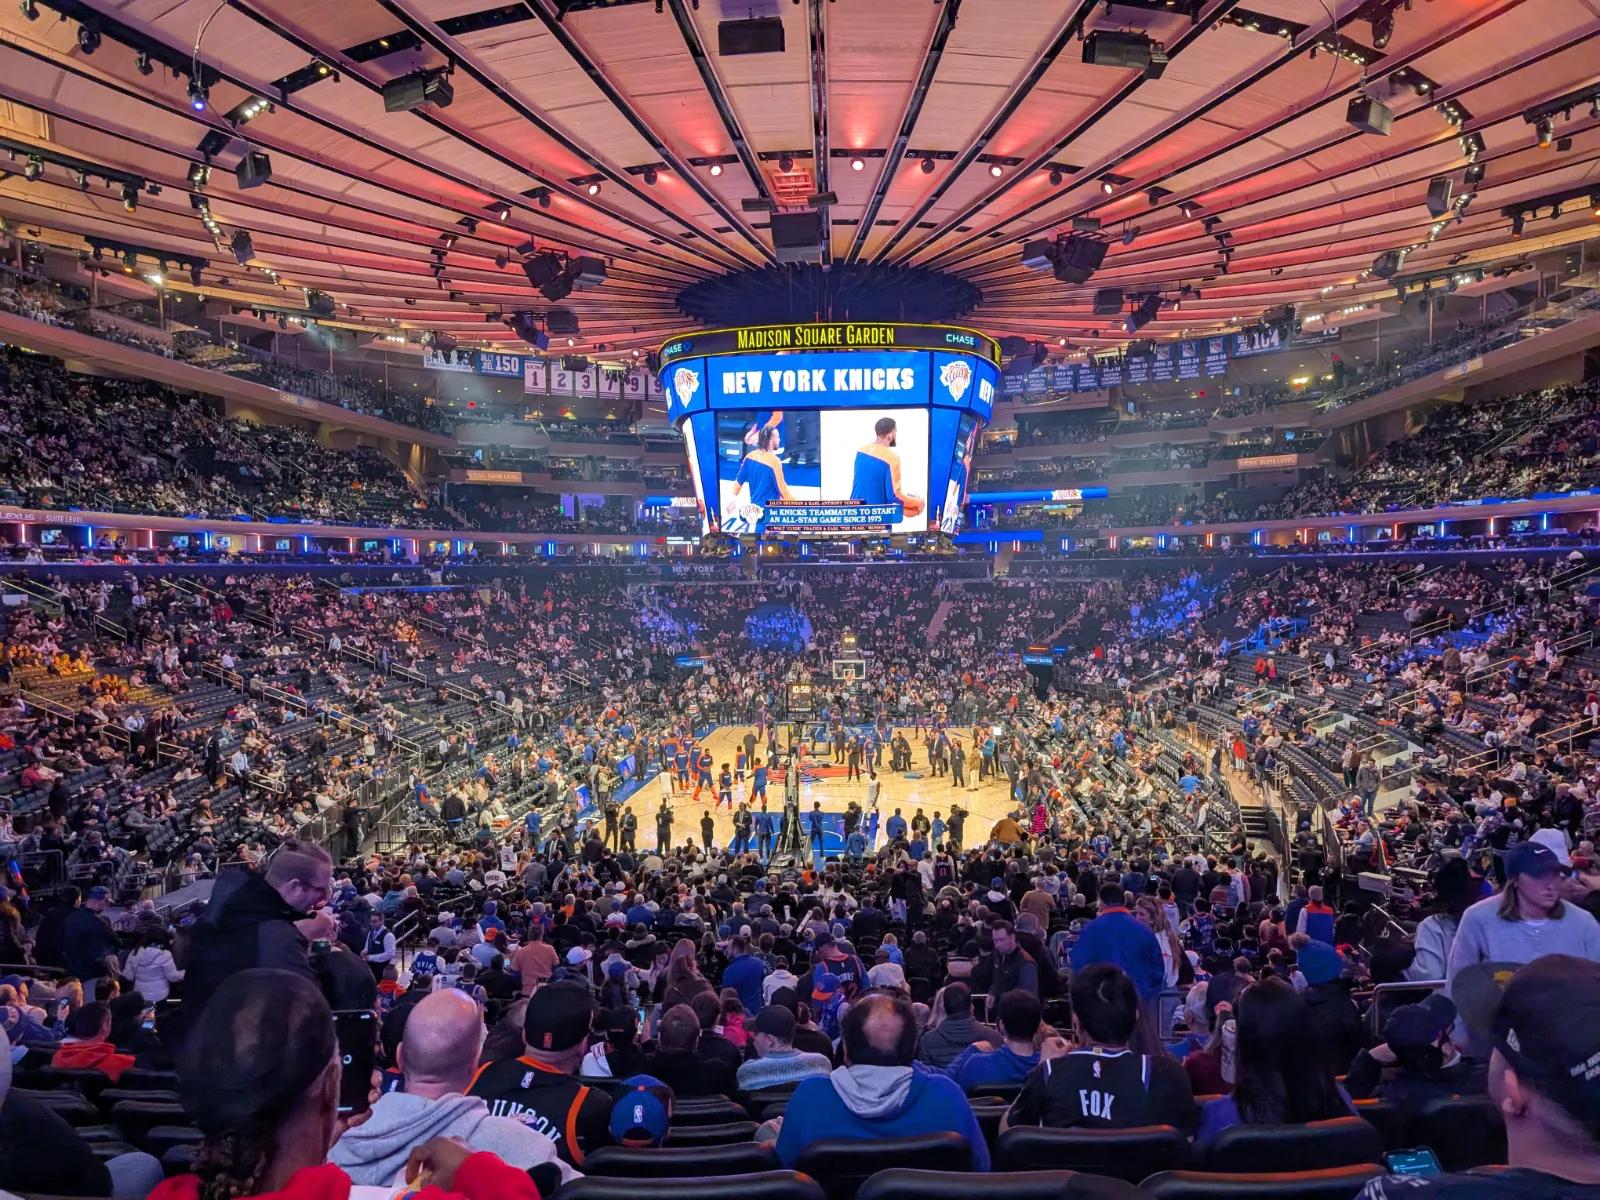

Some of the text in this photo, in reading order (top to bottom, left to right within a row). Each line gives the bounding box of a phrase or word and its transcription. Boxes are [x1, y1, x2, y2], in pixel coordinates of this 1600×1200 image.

[738, 325, 894, 349] MADISON SQUARE GARDEN
[945, 333, 975, 346] CHASE
[496, 355, 519, 372] 150
[532, 371, 539, 386] 1
[557, 373, 566, 388] 2
[582, 375, 591, 389] 3
[630, 377, 639, 392] 9
[723, 368, 914, 394] NEW YORK KNICKS
[0, 512, 83, 523] LEXUS SUITE LEVEL
[810, 508, 857, 516] TEAMMATES
[872, 507, 896, 515] START
[1079, 1089, 1115, 1121] FOX
